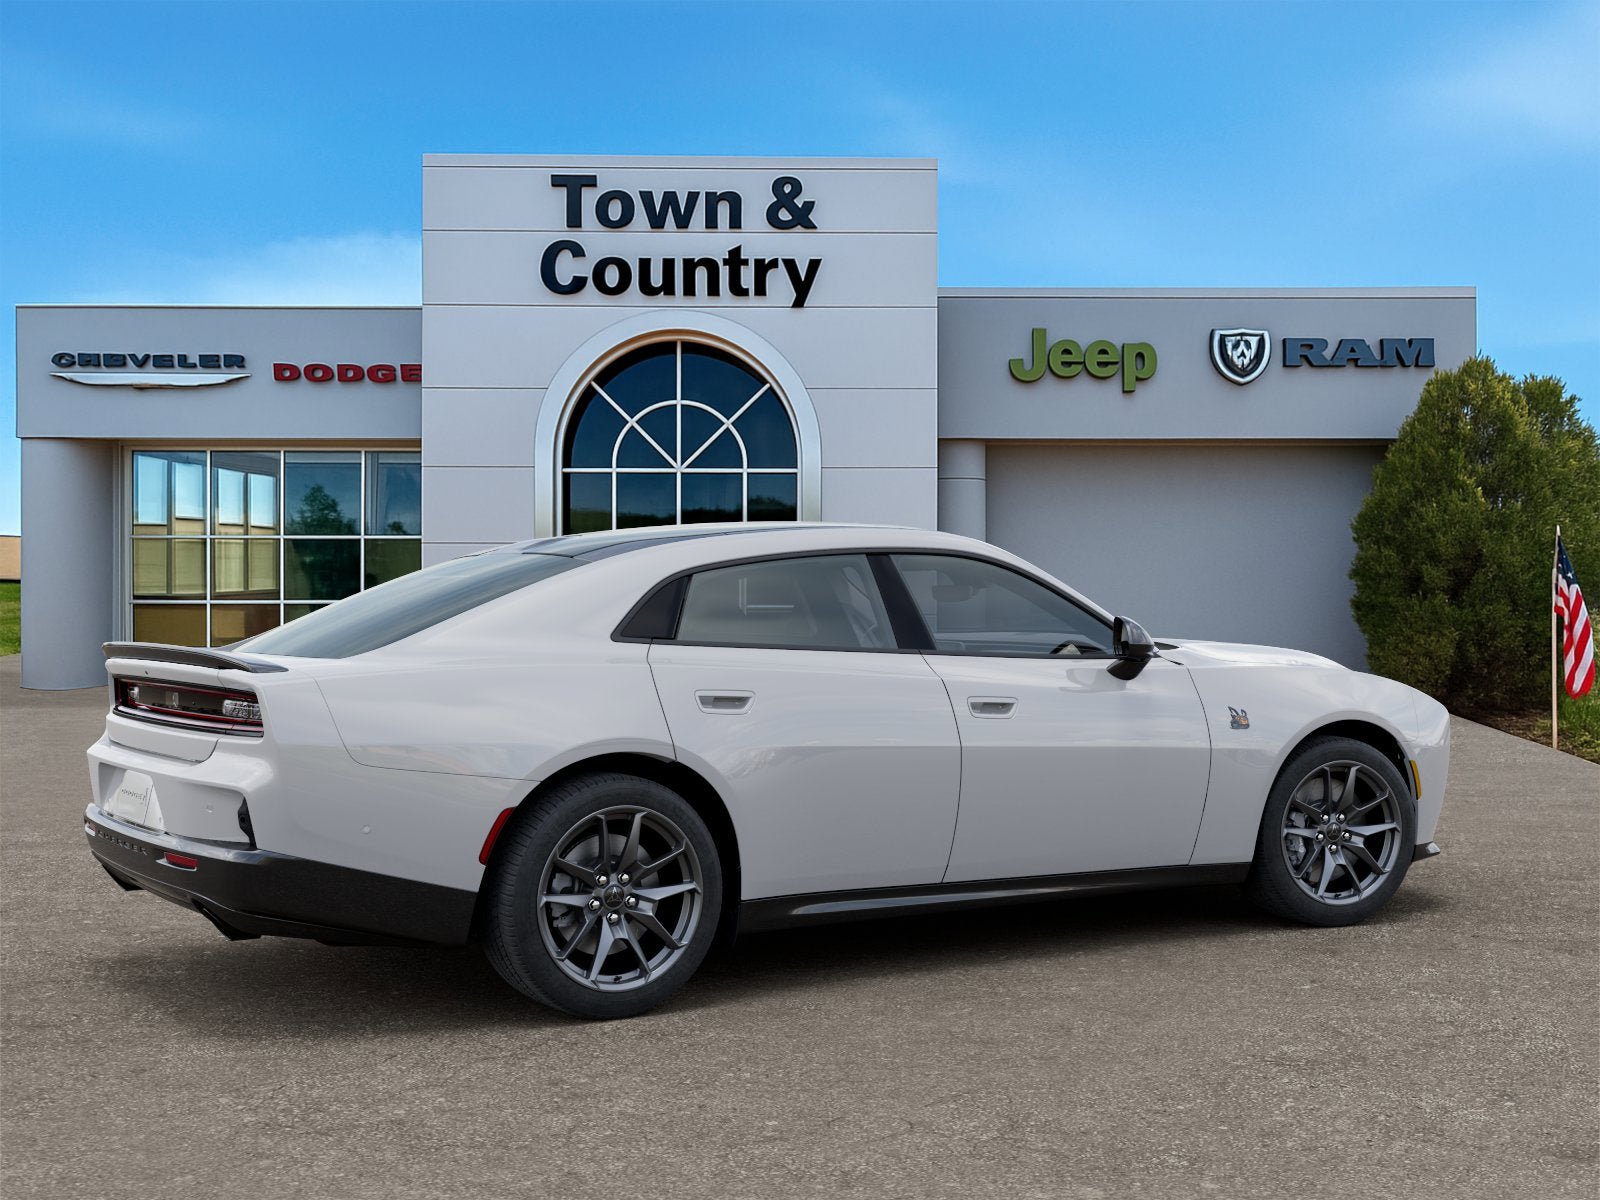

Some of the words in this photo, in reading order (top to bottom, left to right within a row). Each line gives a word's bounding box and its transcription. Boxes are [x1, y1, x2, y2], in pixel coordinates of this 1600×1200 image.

[550, 174, 743, 229] Town
[765, 176, 818, 230] &
[540, 239, 822, 308] Country
[272, 362, 422, 383] DODGE
[1009, 328, 1157, 393] Jeep
[1282, 338, 1436, 367] RAM
